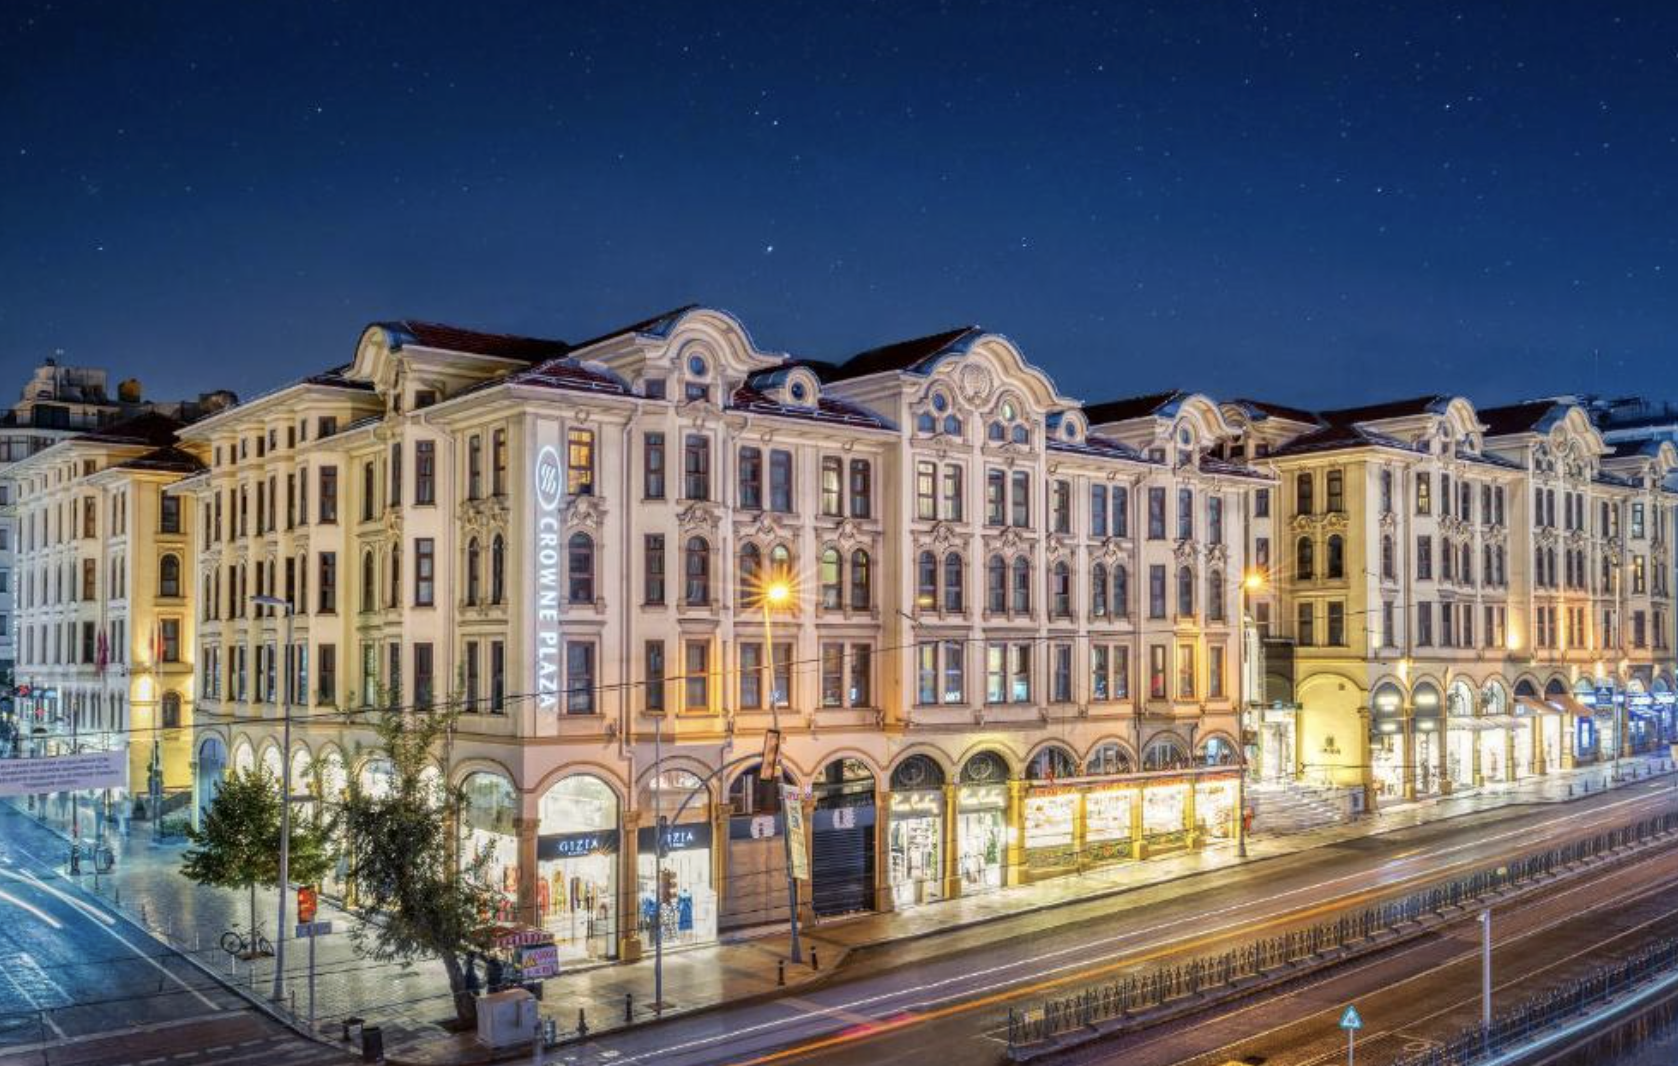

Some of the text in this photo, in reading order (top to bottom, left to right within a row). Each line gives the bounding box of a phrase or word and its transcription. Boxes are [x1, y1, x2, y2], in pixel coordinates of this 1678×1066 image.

[539, 516, 558, 707] CROWNE PLAZA
[558, 838, 599, 852] GIZIA
[666, 832, 694, 844] IZIA
